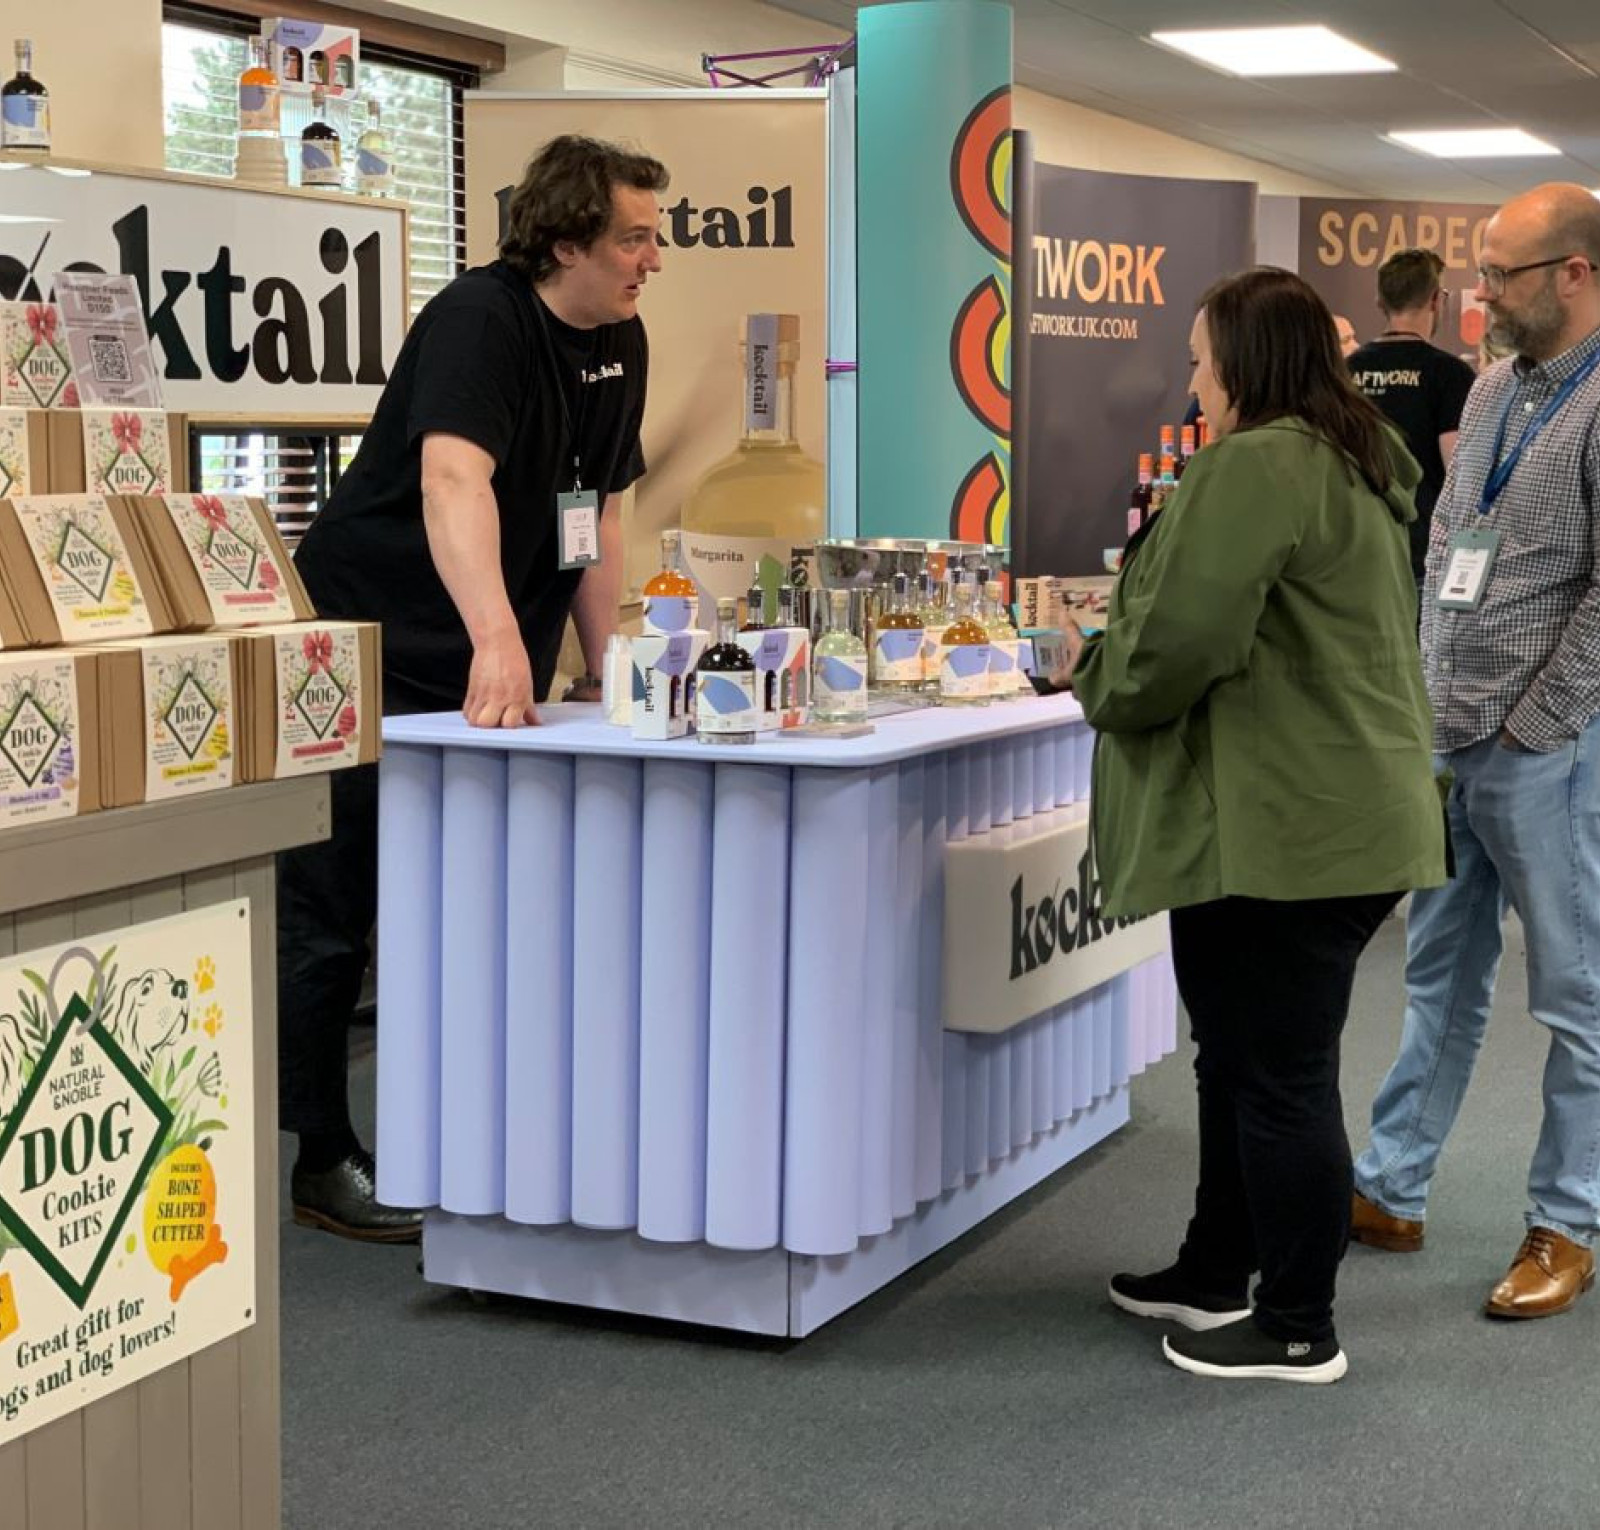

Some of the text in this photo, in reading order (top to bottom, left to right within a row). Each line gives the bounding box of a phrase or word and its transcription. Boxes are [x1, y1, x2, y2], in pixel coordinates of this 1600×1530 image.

[0, 204, 388, 385] ktail
[30, 359, 59, 376] DOG
[115, 467, 145, 483] DOG
[67, 550, 103, 569] DOG
[214, 543, 248, 558] DOG
[691, 547, 745, 563] Margarita
[305, 686, 336, 705] DOG
[175, 703, 207, 724] DOG
[10, 728, 47, 749] DOG
[49, 1064, 105, 1095] NATURAL
[19, 1097, 134, 1193] DOG
[42, 1174, 116, 1221] Cookie
[168, 1179, 201, 1196] BONE
[157, 1201, 206, 1219] SHAPED
[58, 1210, 103, 1249] KITS
[152, 1223, 205, 1243] CUTTER
[16, 1297, 145, 1369] Great gift for
[35, 1359, 73, 1398] and
[79, 1342, 115, 1377] dog
[120, 1310, 176, 1359] lovers!
